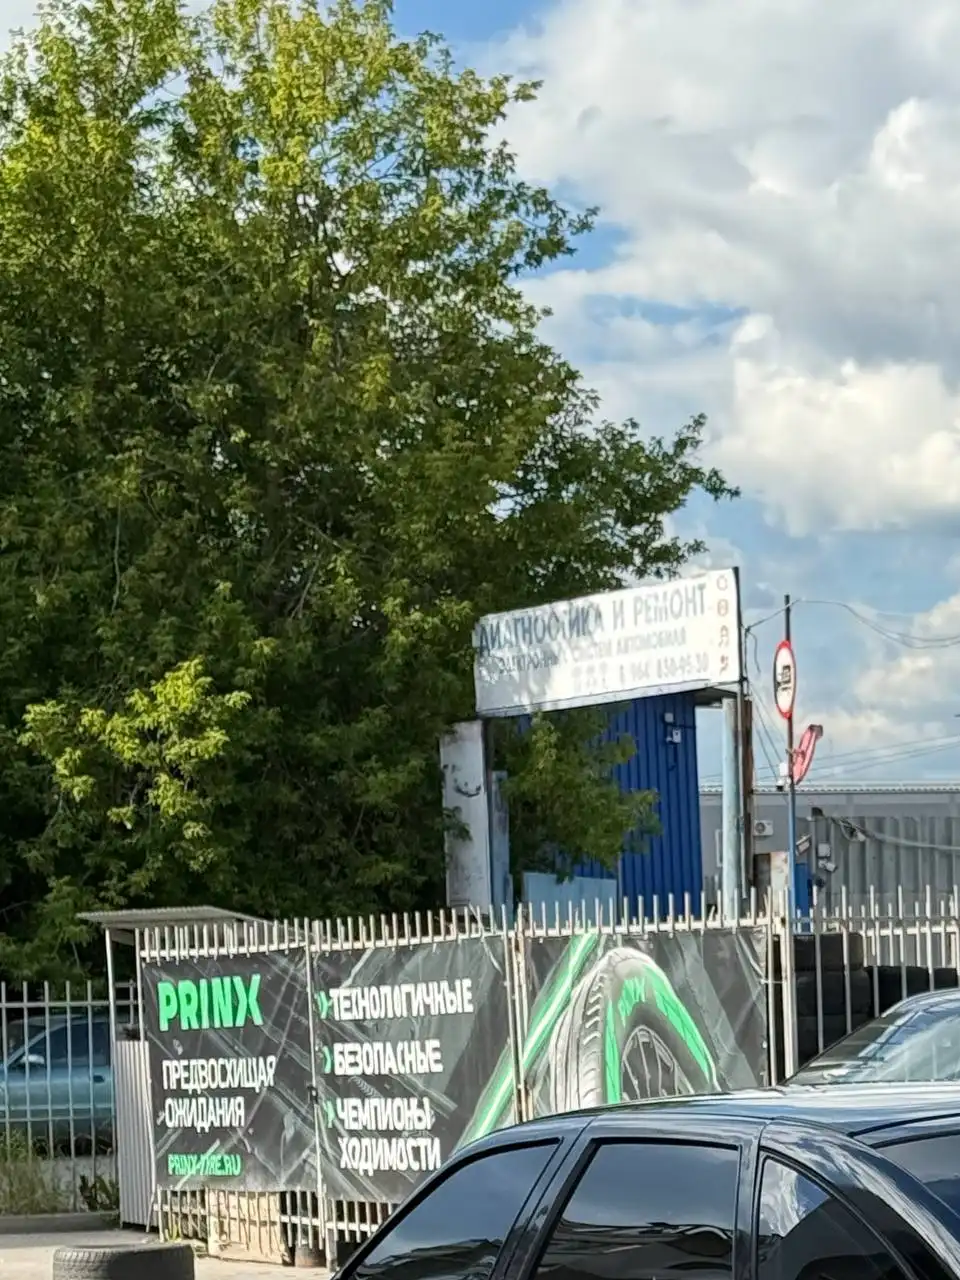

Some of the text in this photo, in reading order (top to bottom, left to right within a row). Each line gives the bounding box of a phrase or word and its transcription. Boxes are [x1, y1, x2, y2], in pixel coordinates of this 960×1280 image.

[612, 600, 624, 631] И
[634, 582, 706, 627] РЕМОНТ
[157, 974, 263, 1032] PRINX
[329, 978, 474, 1021] ТЕХНОЛОГИЧНЫЕ
[162, 1055, 276, 1093] ПРЕДВОСХИЩАЯ
[333, 1039, 443, 1075] БЕЗОПАСНЫЕ
[164, 1097, 244, 1132] ОЖИДАНИЯ
[338, 1097, 434, 1130] ЧЕМПИОНЫ
[338, 1137, 441, 1176] ХОДИМОСТИ
